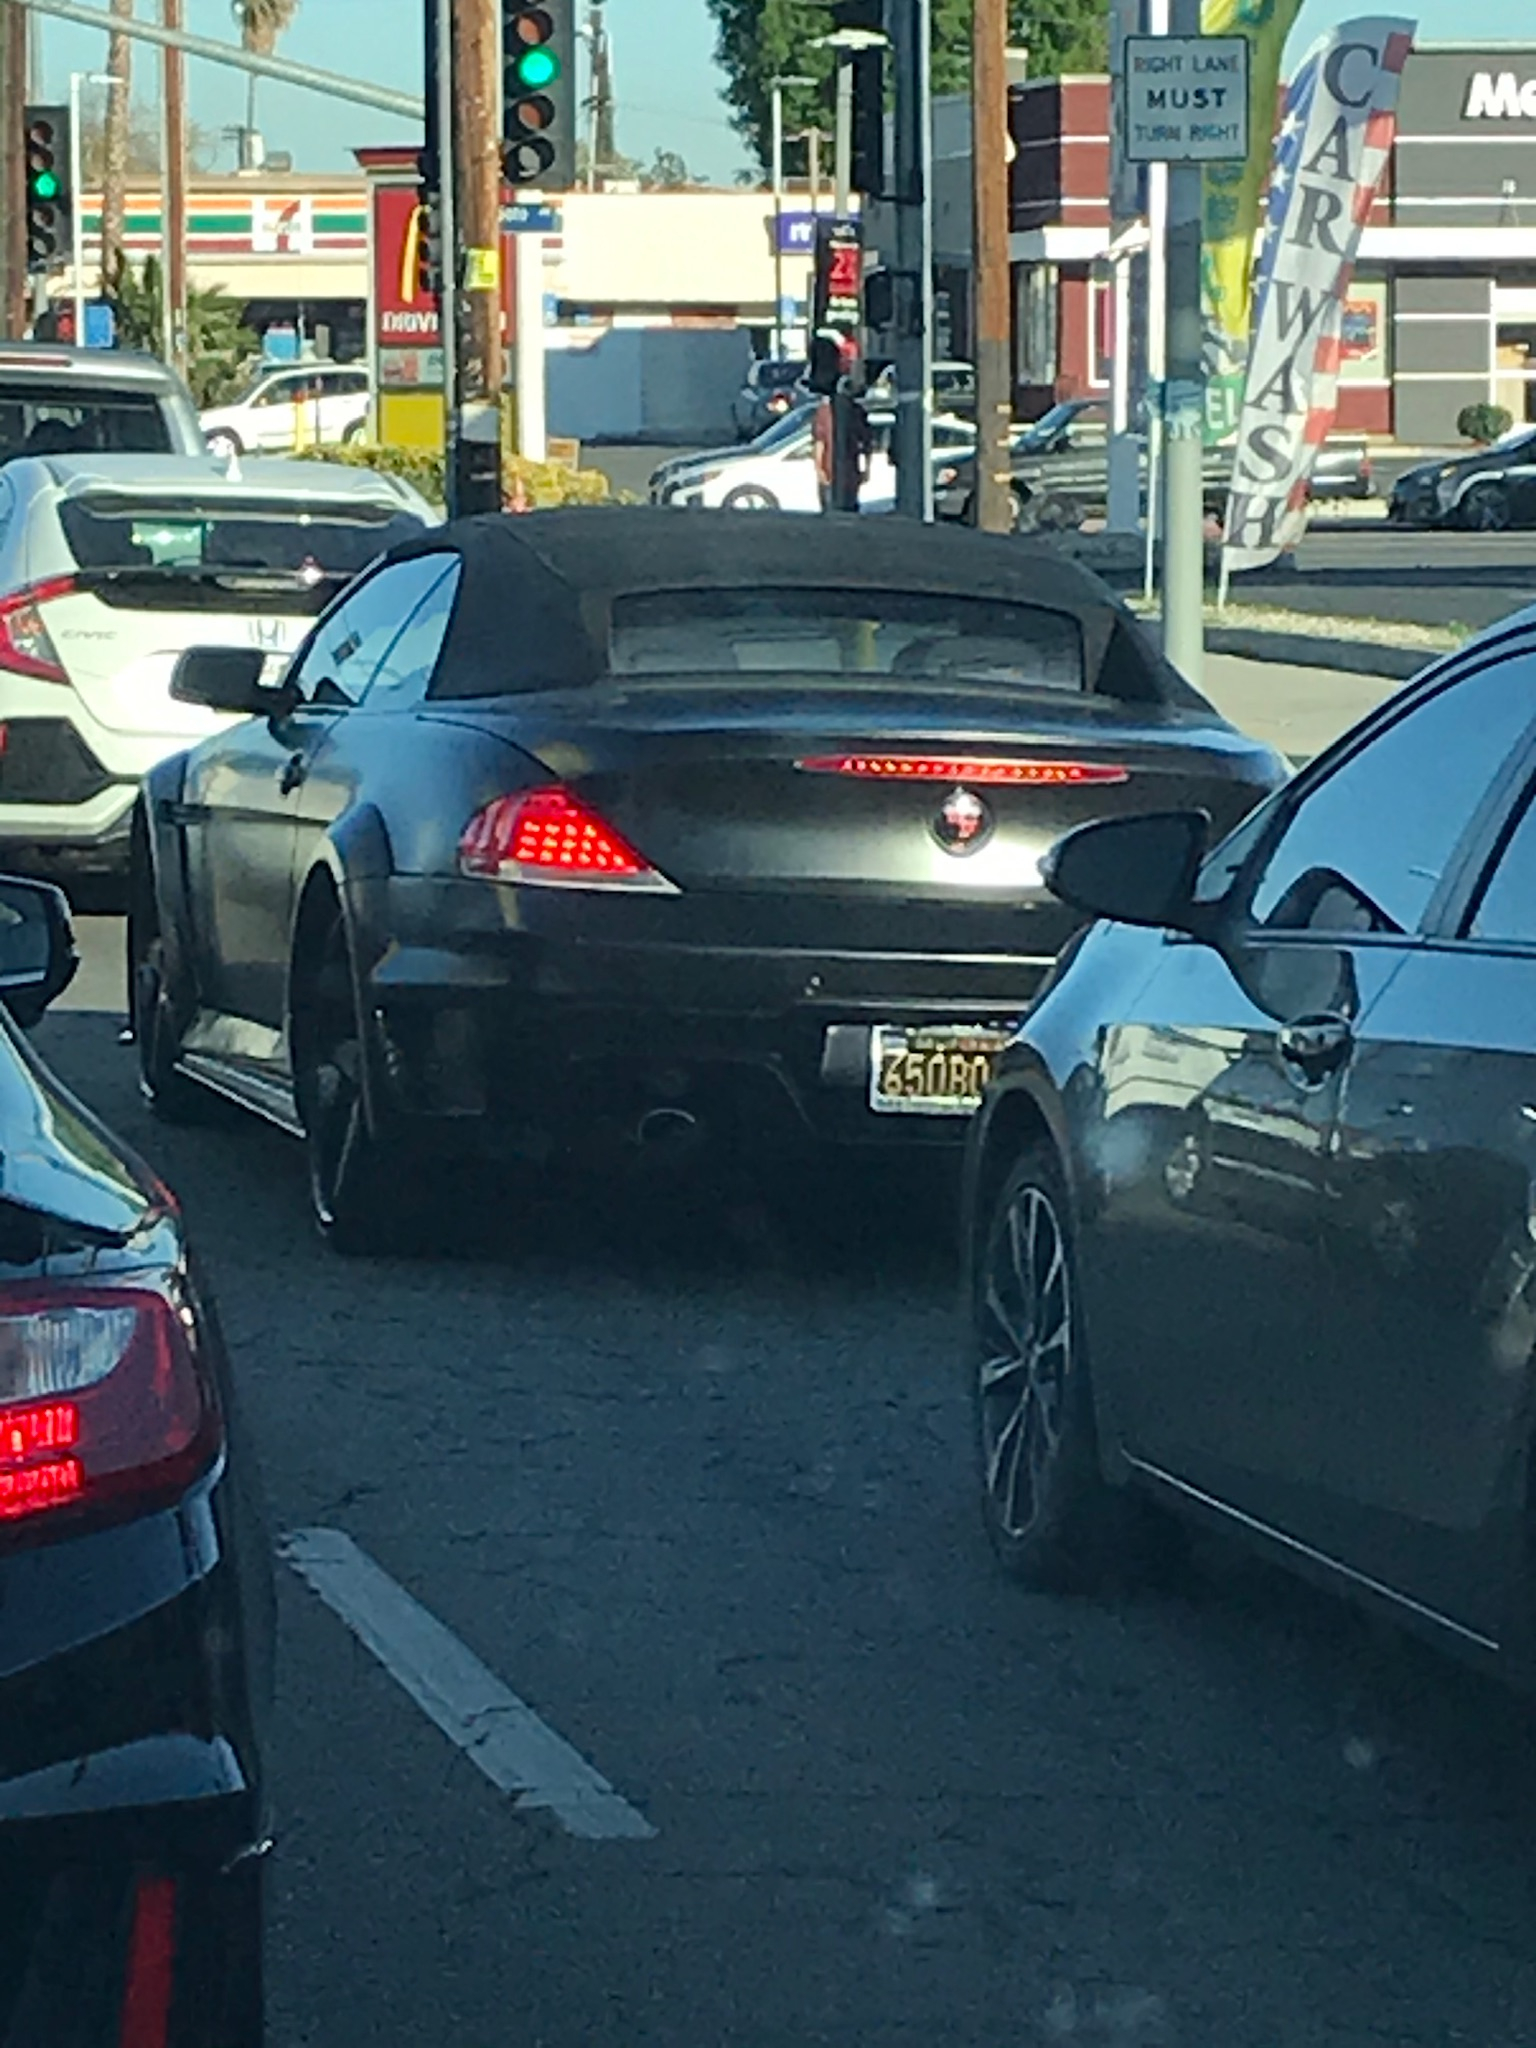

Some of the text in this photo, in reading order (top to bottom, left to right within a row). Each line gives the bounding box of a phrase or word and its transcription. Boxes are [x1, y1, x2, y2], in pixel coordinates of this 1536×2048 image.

[1134, 54, 1238, 73] RIGHT LANE
[1147, 87, 1227, 109] MUST
[1135, 123, 1239, 141] TURN RIGHT
[1285, 43, 1379, 257] CAR
[1221, 280, 1342, 548] WASH
